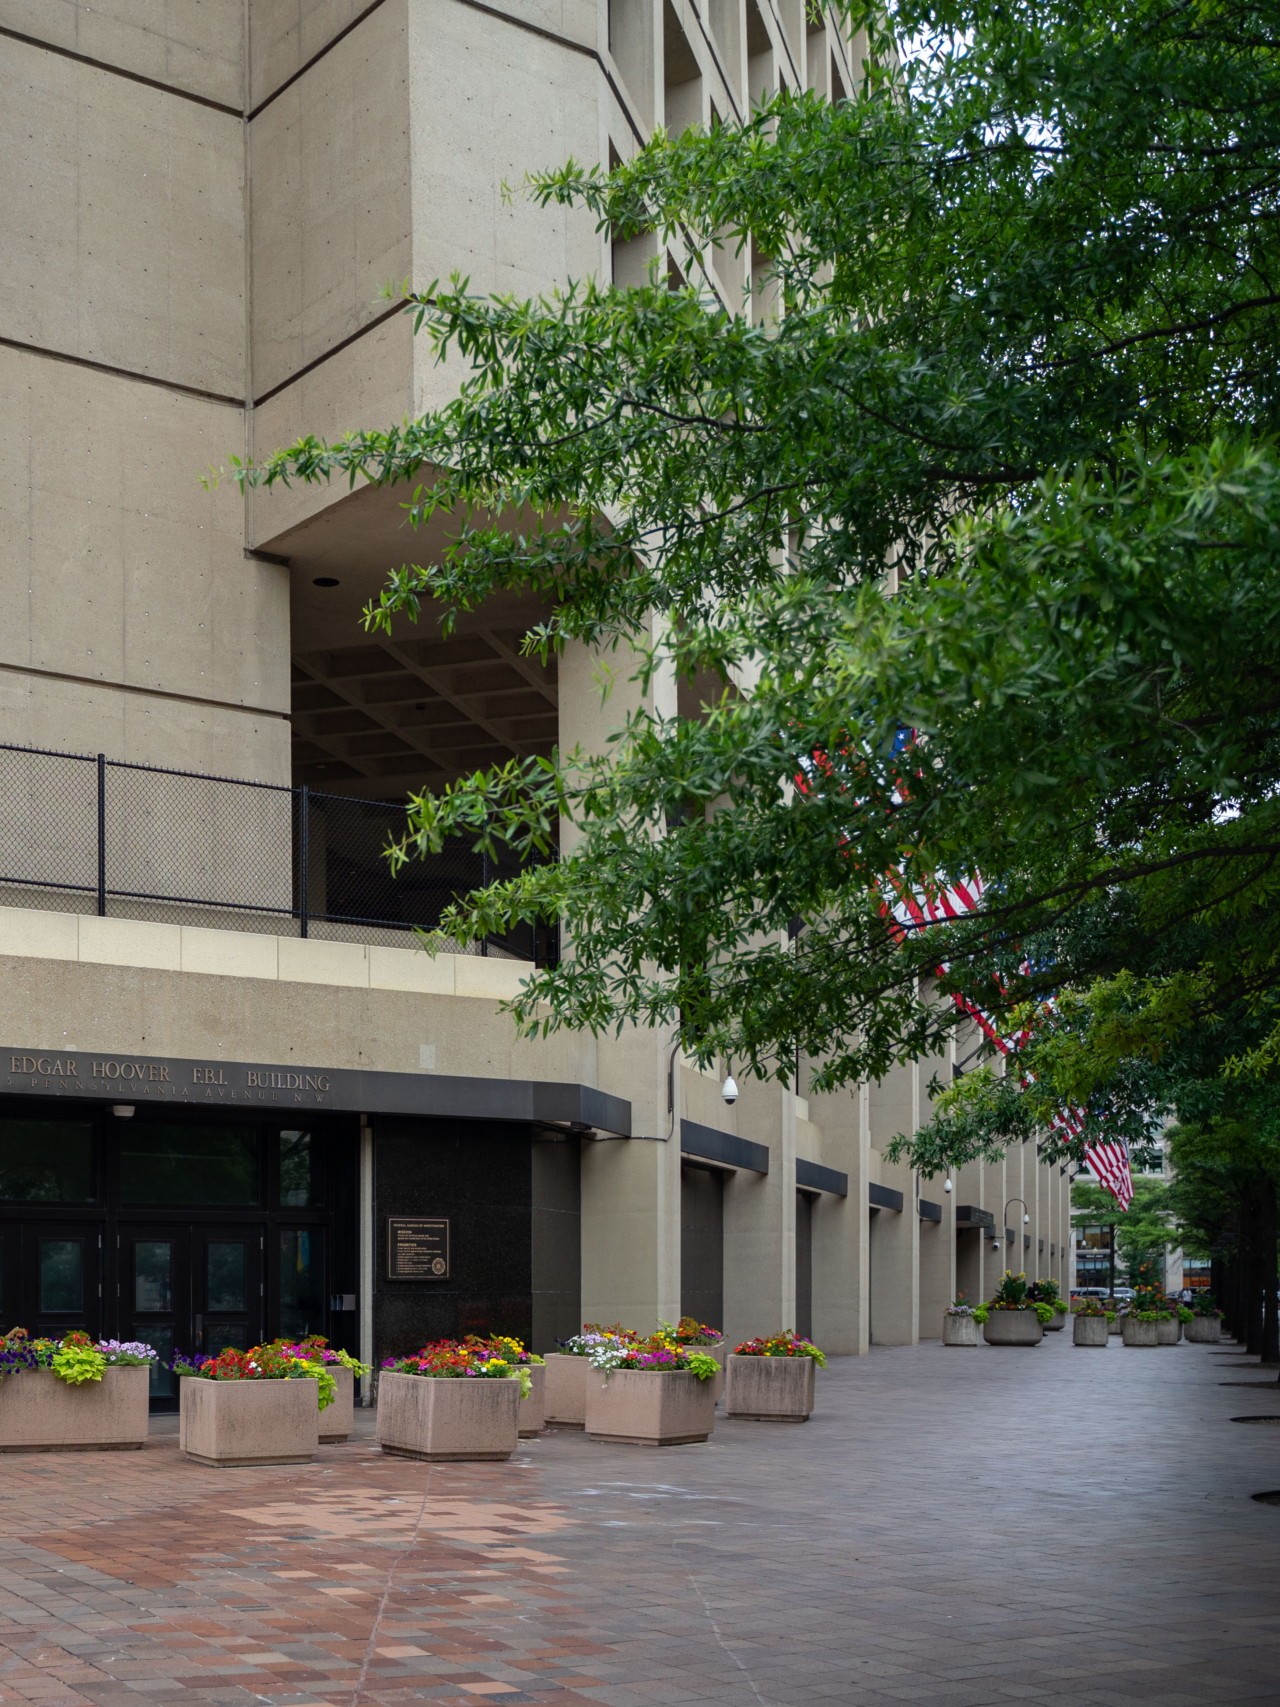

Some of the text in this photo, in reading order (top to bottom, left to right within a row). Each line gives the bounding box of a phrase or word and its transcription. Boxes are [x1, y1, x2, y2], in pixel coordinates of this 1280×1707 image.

[10, 1056, 78, 1076] EDGAR
[91, 1061, 171, 1082] HOOVER
[192, 1067, 228, 1085] F.B.I.
[246, 1071, 330, 1091] BUILDING
[31, 1078, 189, 1095] PENNSYLVANIA
[206, 1088, 278, 1100] AVENUE
